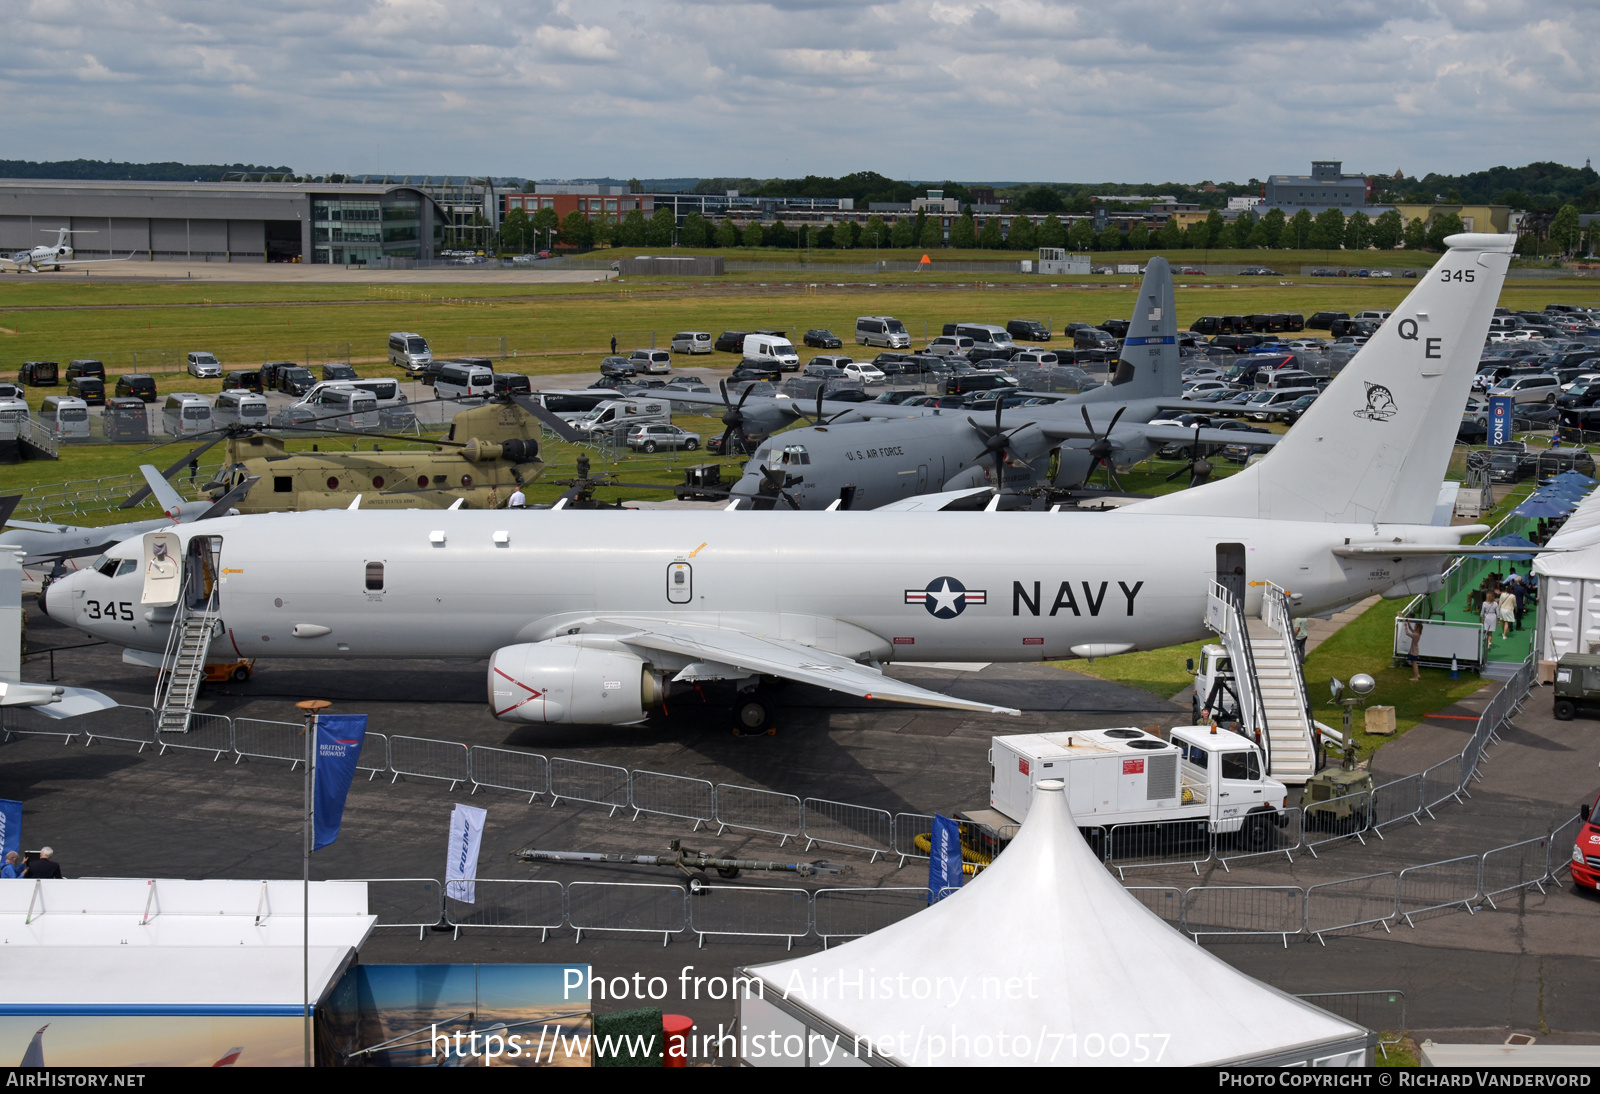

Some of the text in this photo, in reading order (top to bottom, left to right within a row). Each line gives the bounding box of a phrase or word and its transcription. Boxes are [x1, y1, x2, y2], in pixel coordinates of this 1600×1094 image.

[1441, 270, 1475, 282] 345
[1398, 318, 1442, 359] Q E
[1494, 418, 1504, 445] ZONE
[847, 446, 904, 461] U. S. AIR FORCE
[86, 600, 134, 621] 345
[1012, 581, 1144, 617] NAVY
[459, 819, 470, 874] BOEING
[941, 828, 949, 882] BOEING
